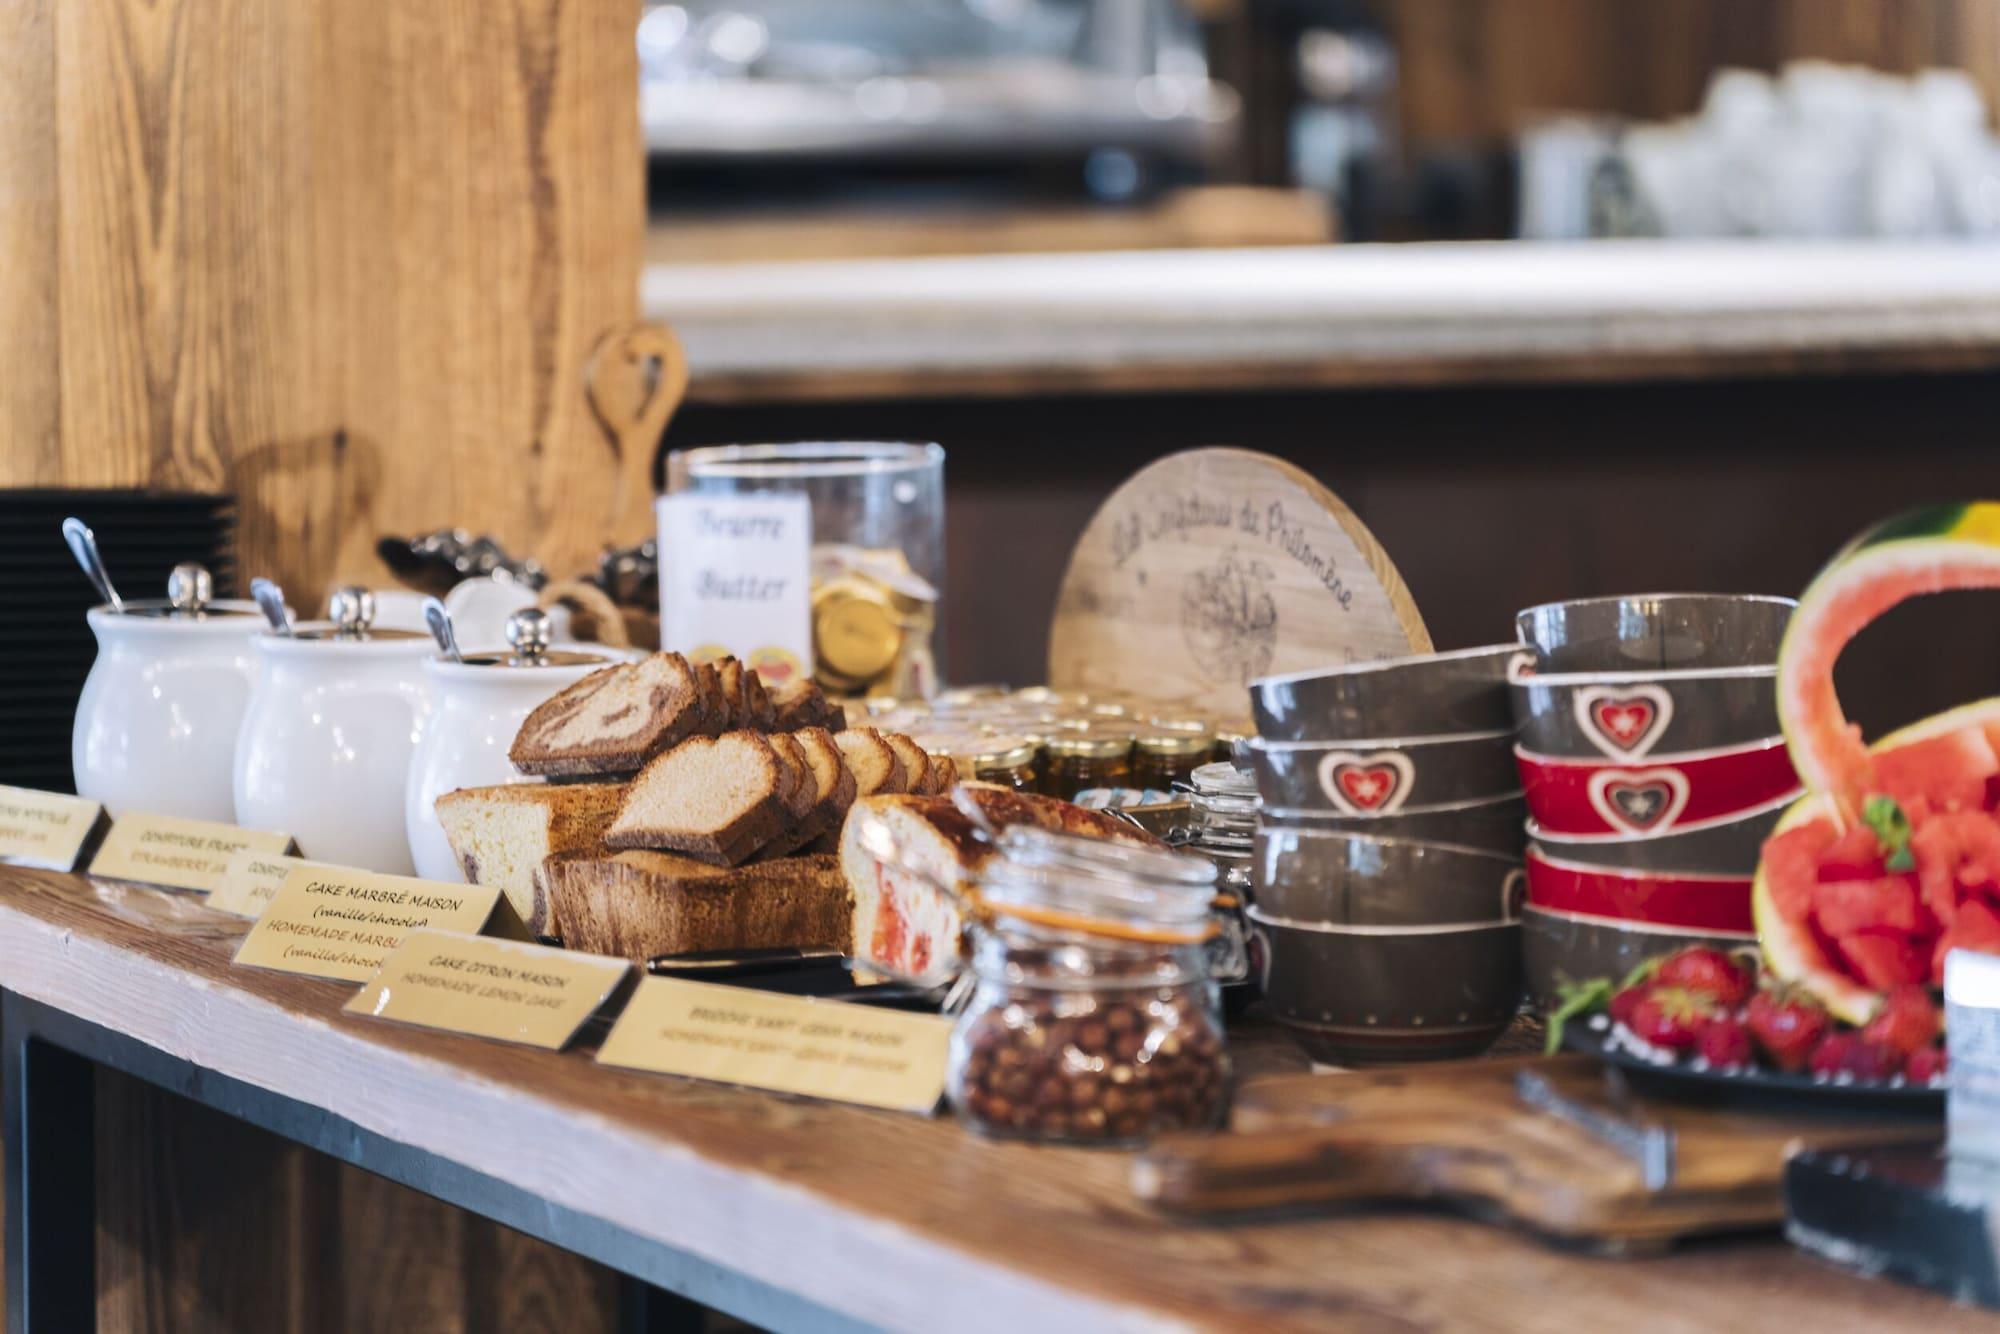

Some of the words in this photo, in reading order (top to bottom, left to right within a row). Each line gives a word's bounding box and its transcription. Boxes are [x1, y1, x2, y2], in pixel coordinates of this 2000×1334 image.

[694, 568, 790, 601] Butter
[305, 881, 344, 897] CAKE
[346, 885, 407, 906] MARBRÉ
[409, 894, 464, 912] MAISON
[266, 919, 348, 942] HOMEMADE
[429, 954, 465, 972] CAKE
[467, 959, 515, 979] CITRON
[517, 969, 571, 989] MAISON
[401, 971, 478, 994] HOMEMADE
[478, 984, 525, 1004] LEMON
[526, 992, 567, 1010] CAKE
